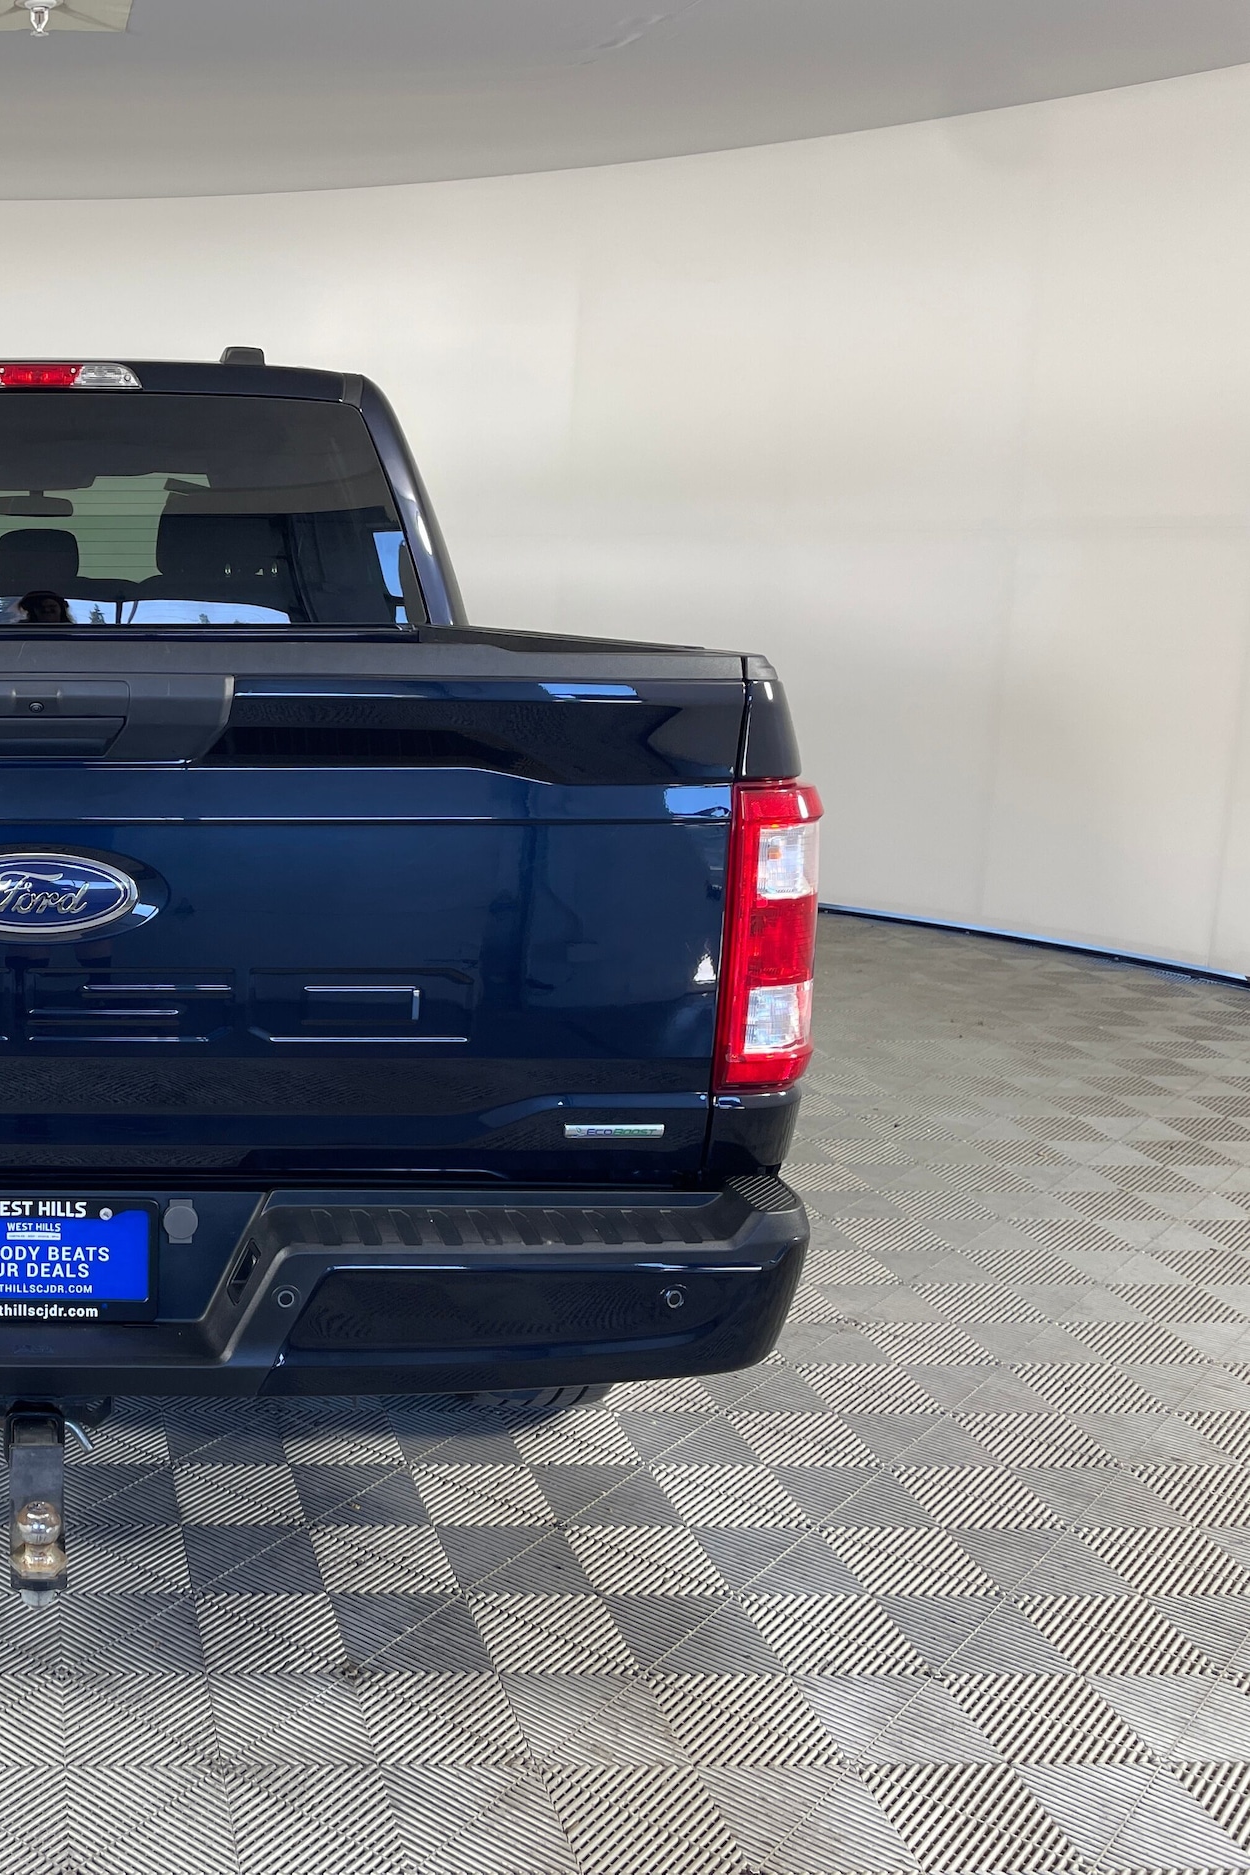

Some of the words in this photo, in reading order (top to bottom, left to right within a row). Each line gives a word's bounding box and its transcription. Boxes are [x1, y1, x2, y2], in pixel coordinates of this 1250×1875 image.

[38, 1201, 87, 1218] HILLS
[7, 1222, 33, 1232] WEST
[36, 1222, 61, 1233] HILLS
[48, 1245, 110, 1262] BEATS
[26, 1262, 90, 1278] DEALS
